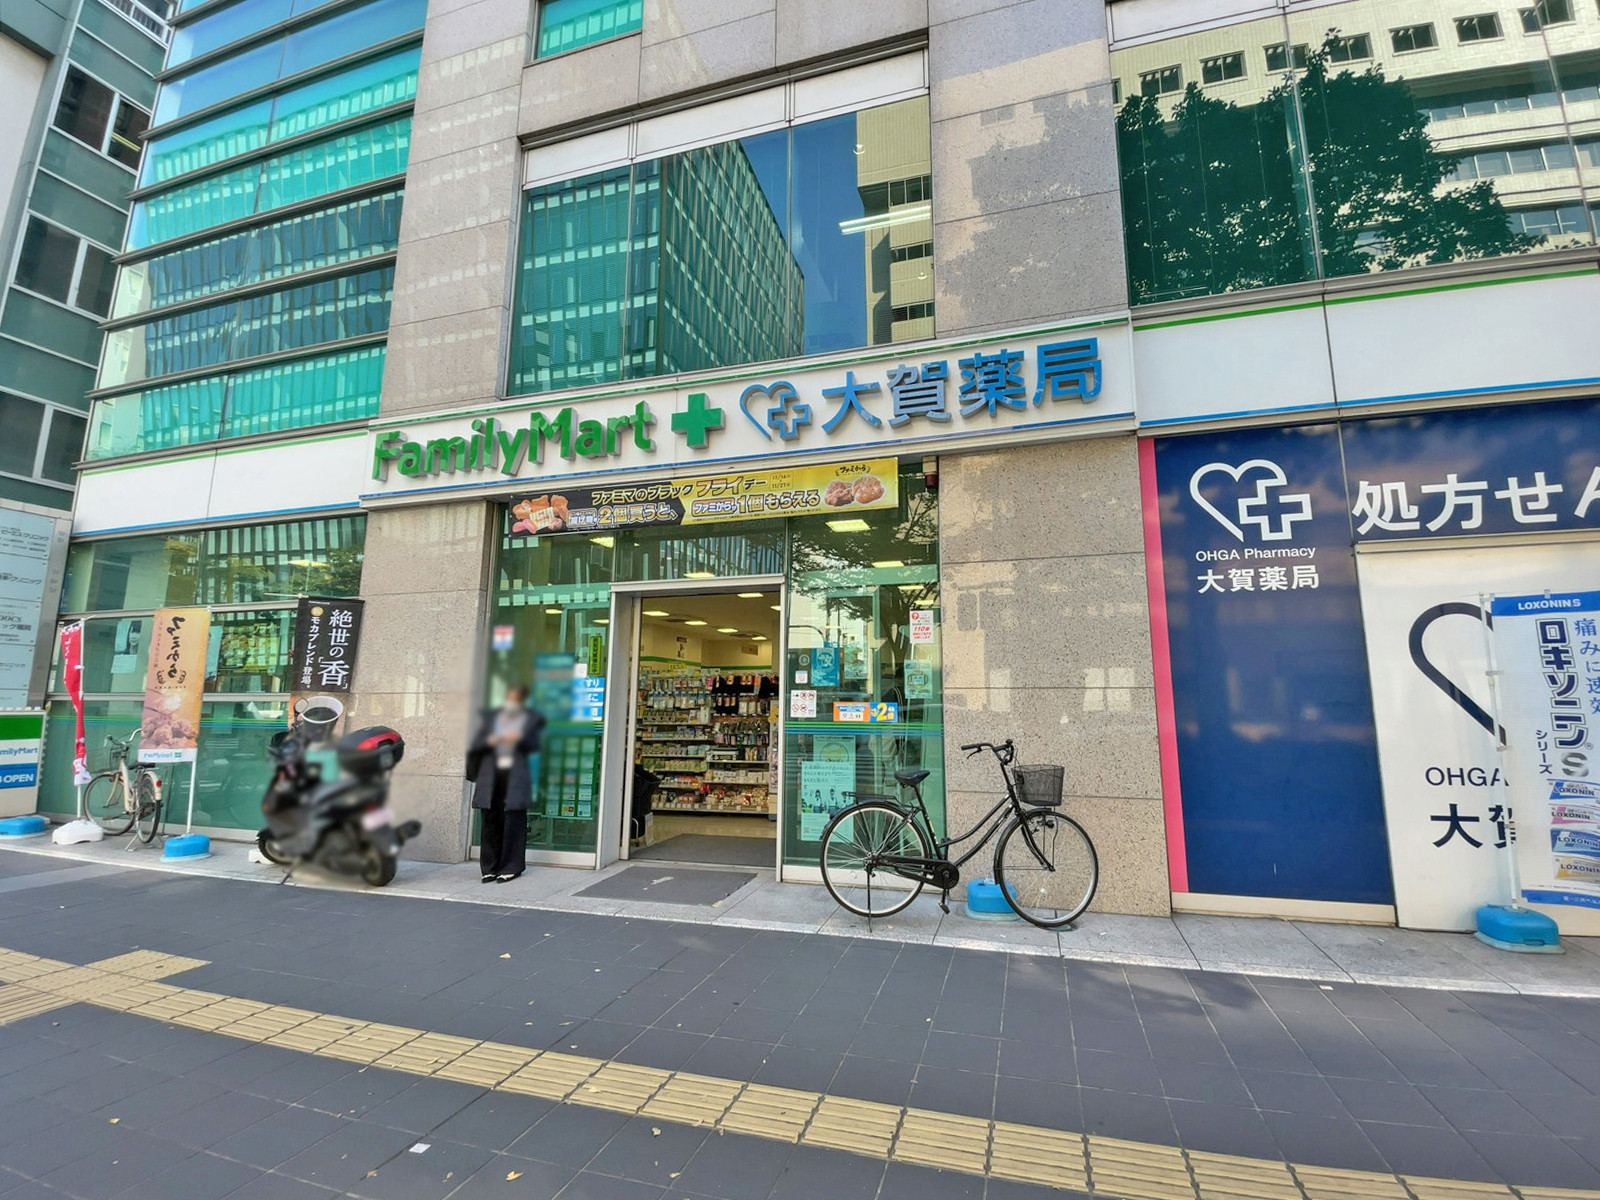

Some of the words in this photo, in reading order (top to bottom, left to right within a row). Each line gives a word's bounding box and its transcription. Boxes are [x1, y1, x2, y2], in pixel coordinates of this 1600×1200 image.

[822, 337, 1103, 435] 大賀薬局
[372, 399, 656, 482] FamilyMart
[1195, 549, 1240, 562] OHGA
[1244, 547, 1316, 559] Pharmacy
[1197, 565, 1320, 594] 大賀薬局
[1536, 729, 1552, 775] シリーズ
[1425, 766, 1509, 786] OHGA
[1554, 786, 1595, 796] LOXONIN
[1551, 811, 1591, 820] LOXONIN
